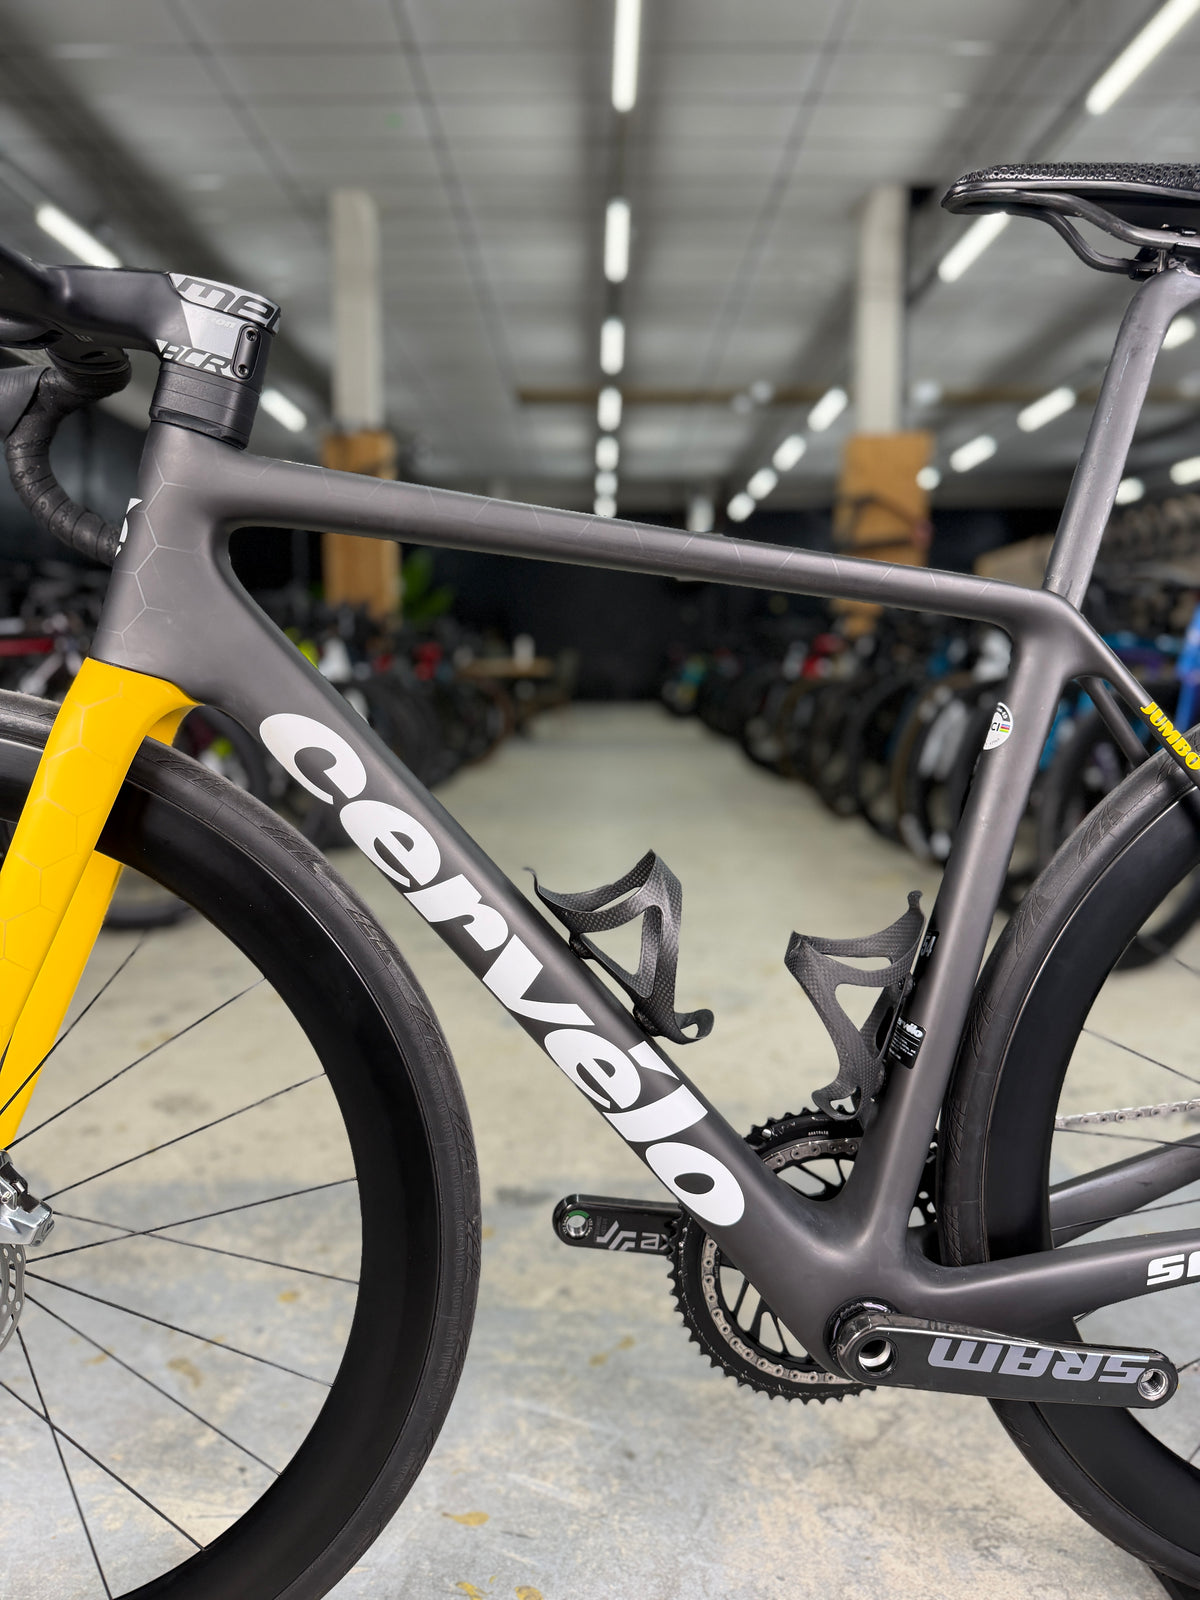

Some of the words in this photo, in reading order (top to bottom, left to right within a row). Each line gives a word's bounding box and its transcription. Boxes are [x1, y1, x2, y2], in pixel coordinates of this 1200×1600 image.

[991, 722, 1001, 732] CI
[1140, 701, 1200, 770] JUMBO
[259, 712, 745, 1227] cervélo
[920, 935, 937, 957] 54
[928, 1337, 1149, 1384] SRAM
